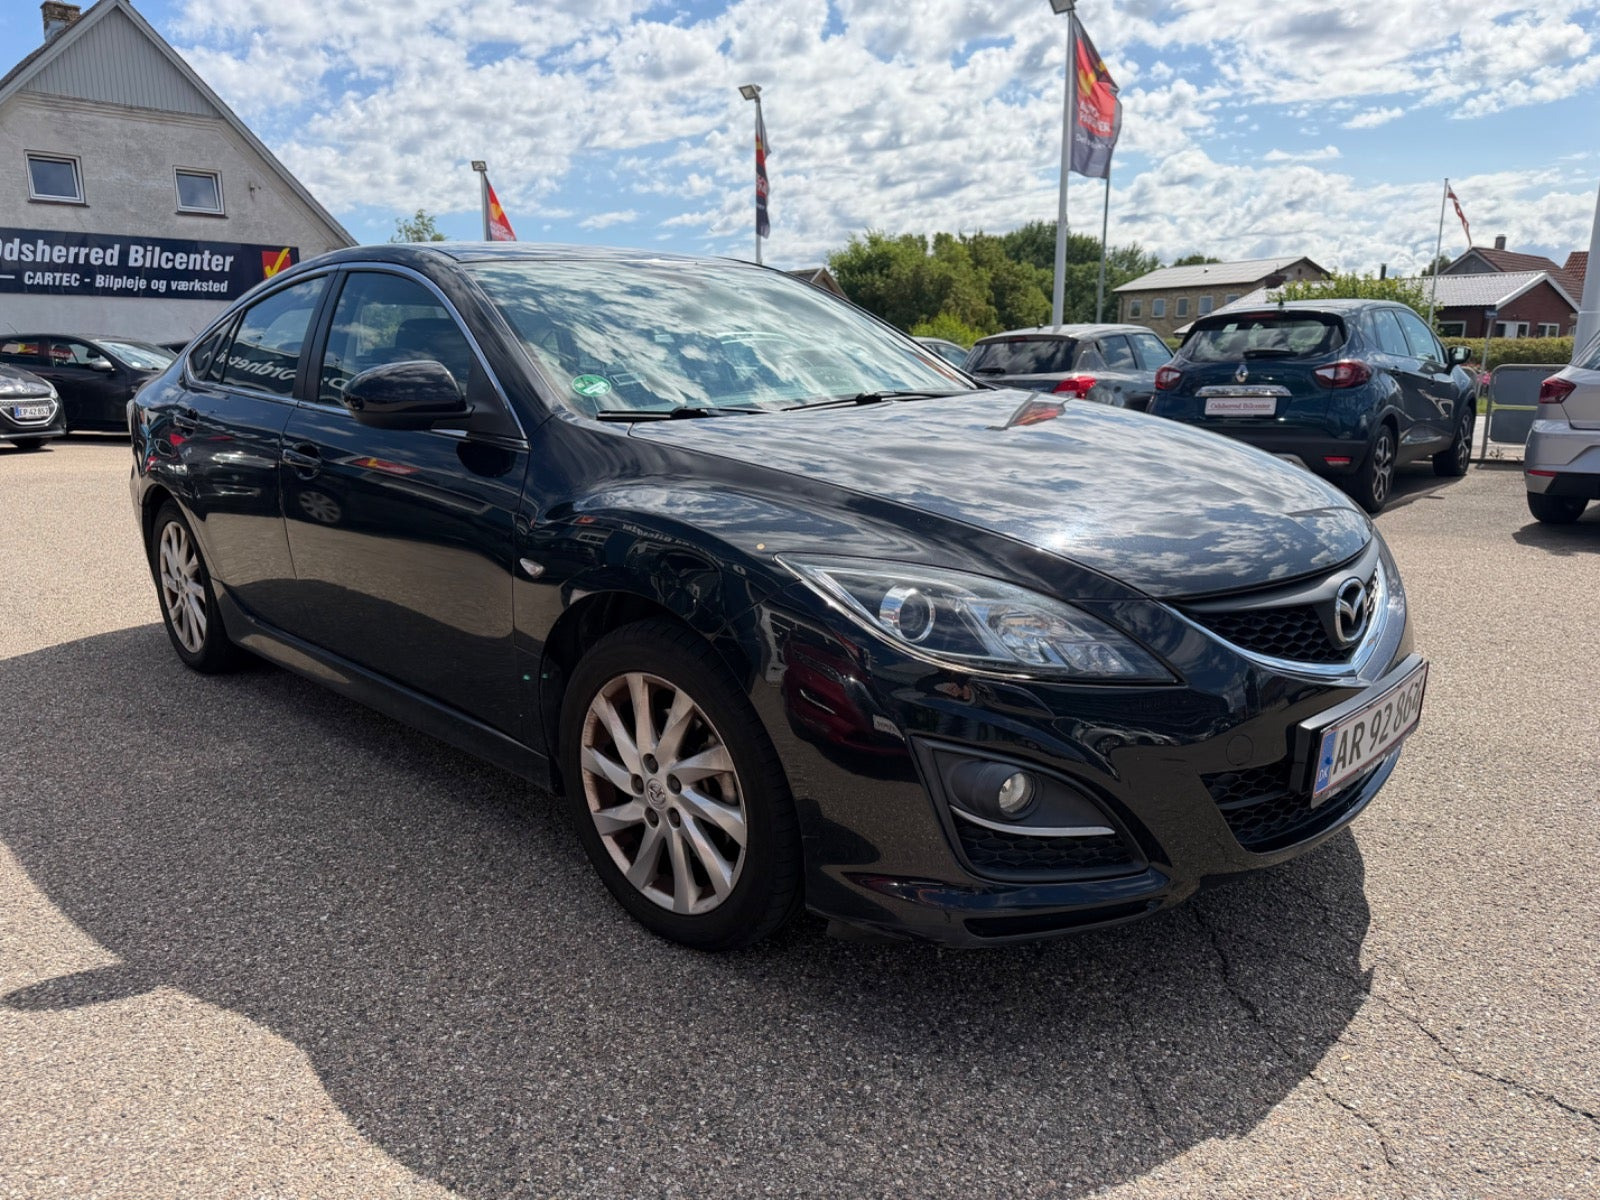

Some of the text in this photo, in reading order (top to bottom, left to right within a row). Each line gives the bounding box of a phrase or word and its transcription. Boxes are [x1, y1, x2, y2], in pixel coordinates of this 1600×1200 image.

[0, 238, 234, 272] dsherred Bilcenter
[24, 271, 80, 287] CARTEC
[95, 274, 147, 291] Bilpleje
[151, 279, 167, 292] og
[170, 278, 229, 292] værksted
[1333, 721, 1365, 775] AR
[1369, 702, 1393, 752] 92
